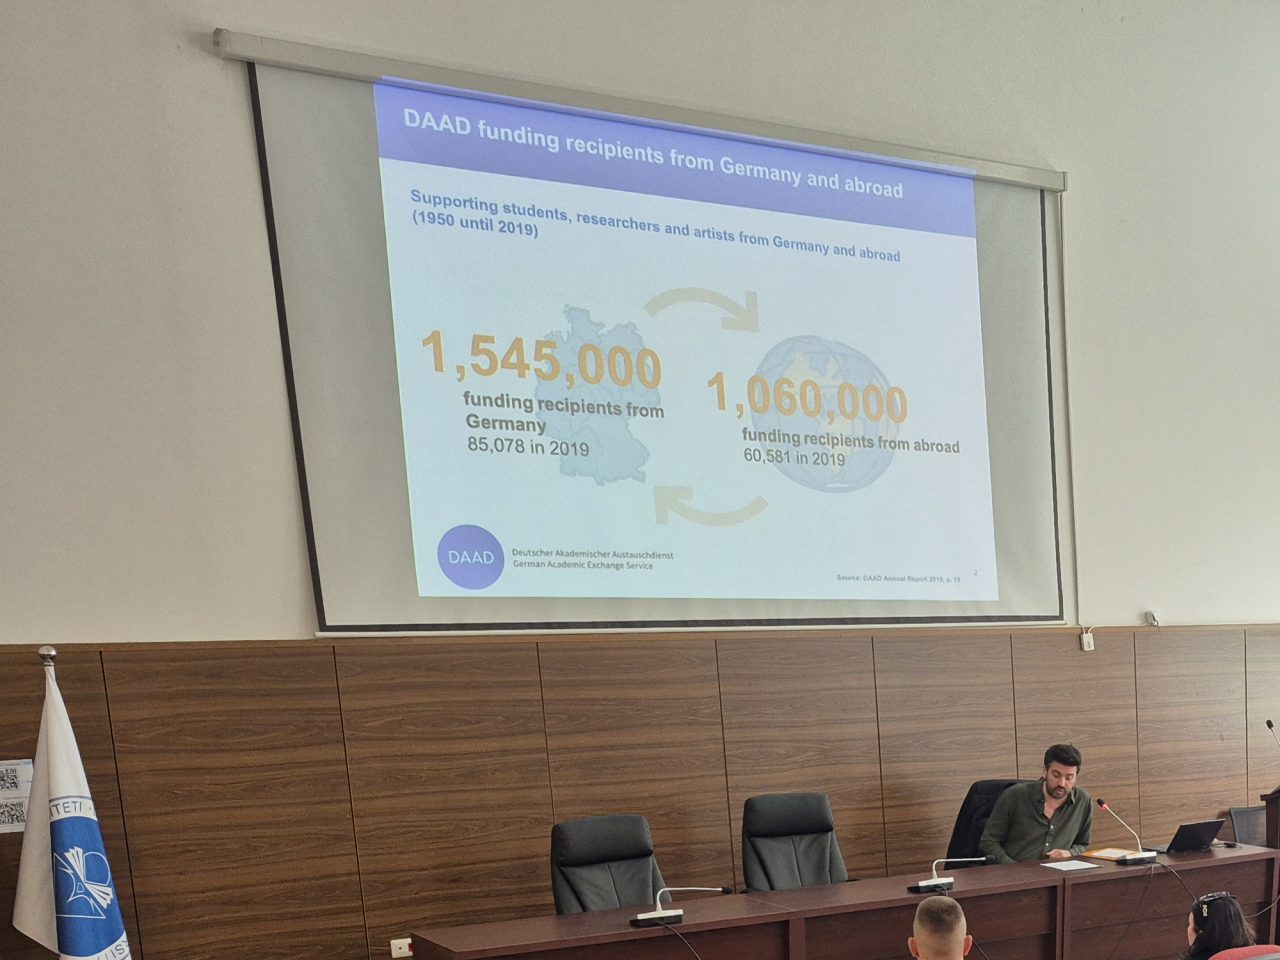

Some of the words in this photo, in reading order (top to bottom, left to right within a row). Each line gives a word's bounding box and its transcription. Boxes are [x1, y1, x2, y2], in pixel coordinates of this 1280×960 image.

[403, 108, 471, 135] DAAD
[478, 120, 559, 152] funding
[566, 136, 664, 164] recipients
[670, 149, 714, 172] from
[720, 156, 801, 188] Germany
[808, 171, 839, 190] and
[845, 179, 903, 198] abroad
[410, 189, 498, 215] Supporting
[503, 202, 572, 223] students,
[576, 212, 660, 233] researchers
[665, 223, 689, 237] and
[694, 227, 735, 242] artists
[739, 231, 769, 247] from
[773, 235, 829, 256] Germany
[833, 244, 856, 257] and
[860, 247, 900, 262] abroad
[412, 209, 455, 227] (1950
[460, 215, 493, 231] until
[498, 220, 538, 240] 2019)
[422, 330, 662, 390] 1,545,000
[463, 390, 534, 413] funding
[538, 397, 622, 417] recipients
[626, 401, 664, 418] from
[707, 371, 908, 426] 1,060,000
[465, 414, 547, 436] Germany
[467, 436, 525, 454] 85,078
[530, 439, 545, 455] in
[550, 441, 589, 457] 2019
[742, 427, 800, 447] funding
[804, 433, 874, 450] recipients
[878, 435, 910, 451] from
[914, 439, 960, 453] abroad
[744, 447, 791, 464] 60,581
[796, 451, 808, 465] in
[812, 452, 846, 467] 2019
[448, 550, 495, 564] DAAD
[512, 548, 553, 557] Deutscher
[555, 549, 610, 558] Akademischer
[612, 550, 674, 560] Austauschdienst
[513, 560, 545, 568] German
[547, 560, 585, 569] Academic
[587, 561, 624, 571] Exchange
[626, 562, 653, 570] Service
